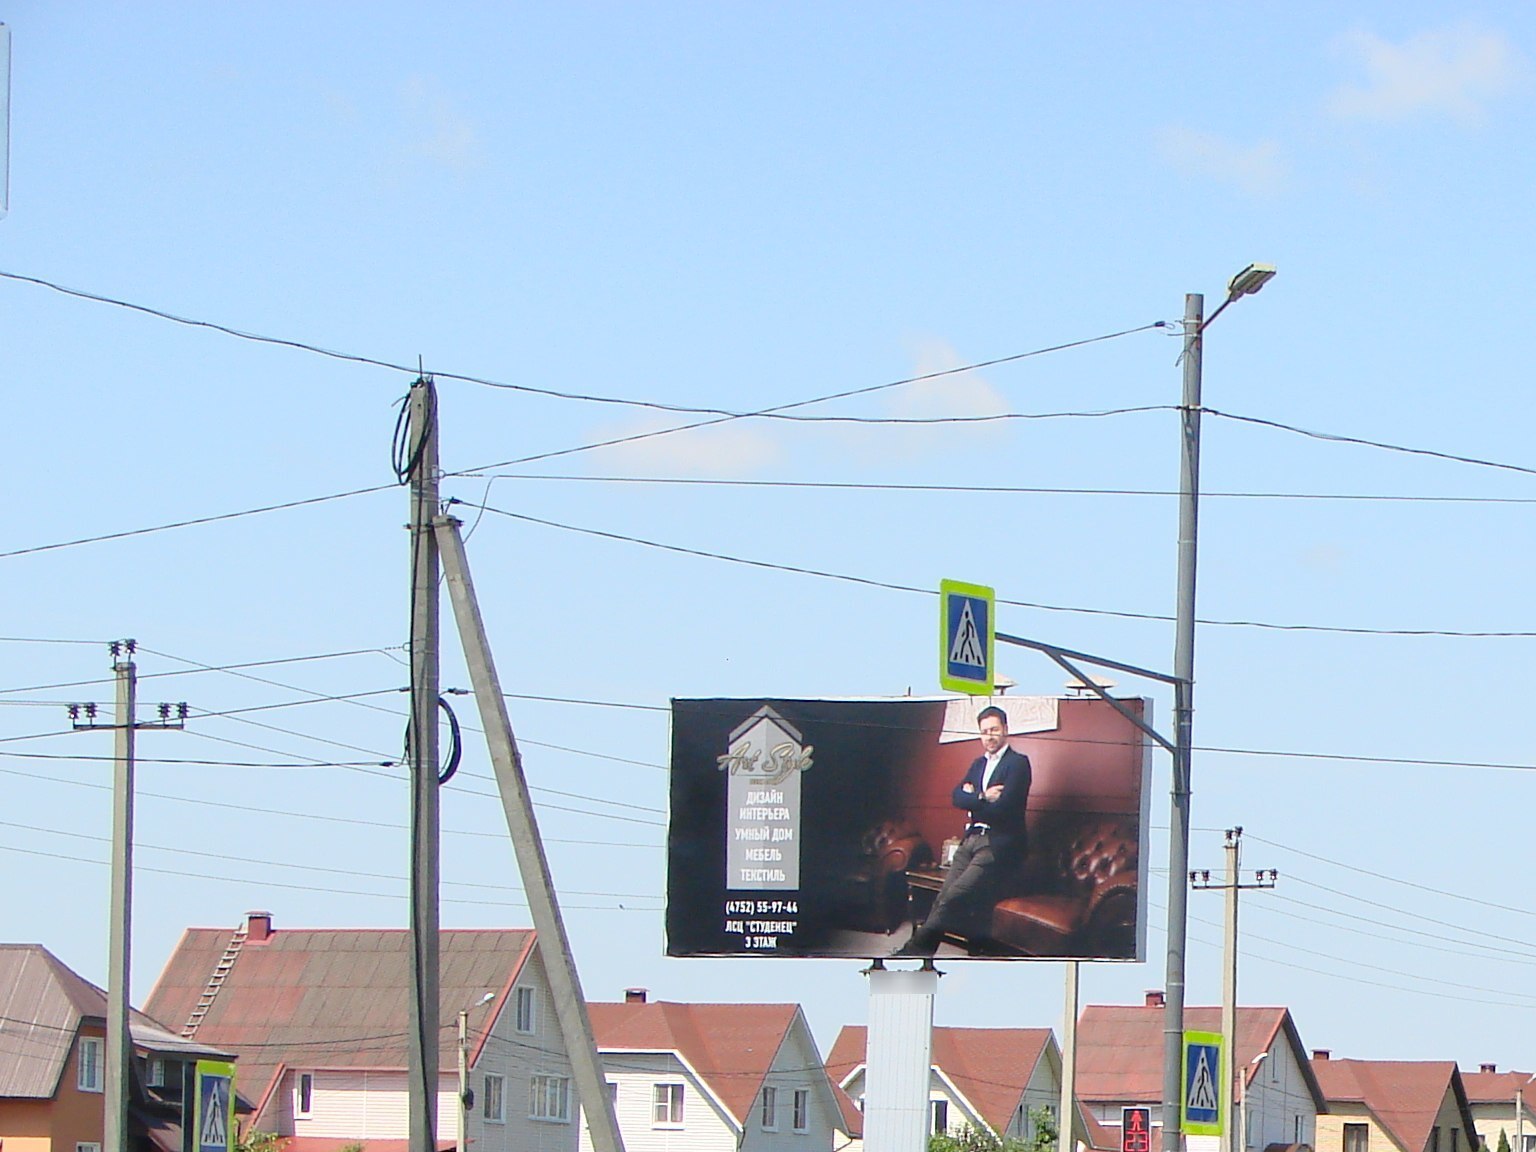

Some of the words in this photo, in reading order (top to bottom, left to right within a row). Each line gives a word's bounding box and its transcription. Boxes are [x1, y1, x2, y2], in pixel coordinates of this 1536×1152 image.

[717, 741, 761, 775] Art
[762, 742, 814, 785] Style
[746, 790, 783, 805] ДИЗАЙН
[740, 807, 790, 820] ИНТЕРЬЕРА
[735, 826, 770, 840] УМНЫЙ
[772, 828, 793, 842] ДОМ
[745, 848, 782, 861] МЕБЕЛЬ
[741, 868, 786, 882] ТЕКСТИЛЬ
[726, 901, 755, 915] (4752)
[745, 920, 798, 934] "СТУДЕНЕЦ"
[745, 936, 751, 948] 3
[753, 936, 777, 948] ЭТАЖ
